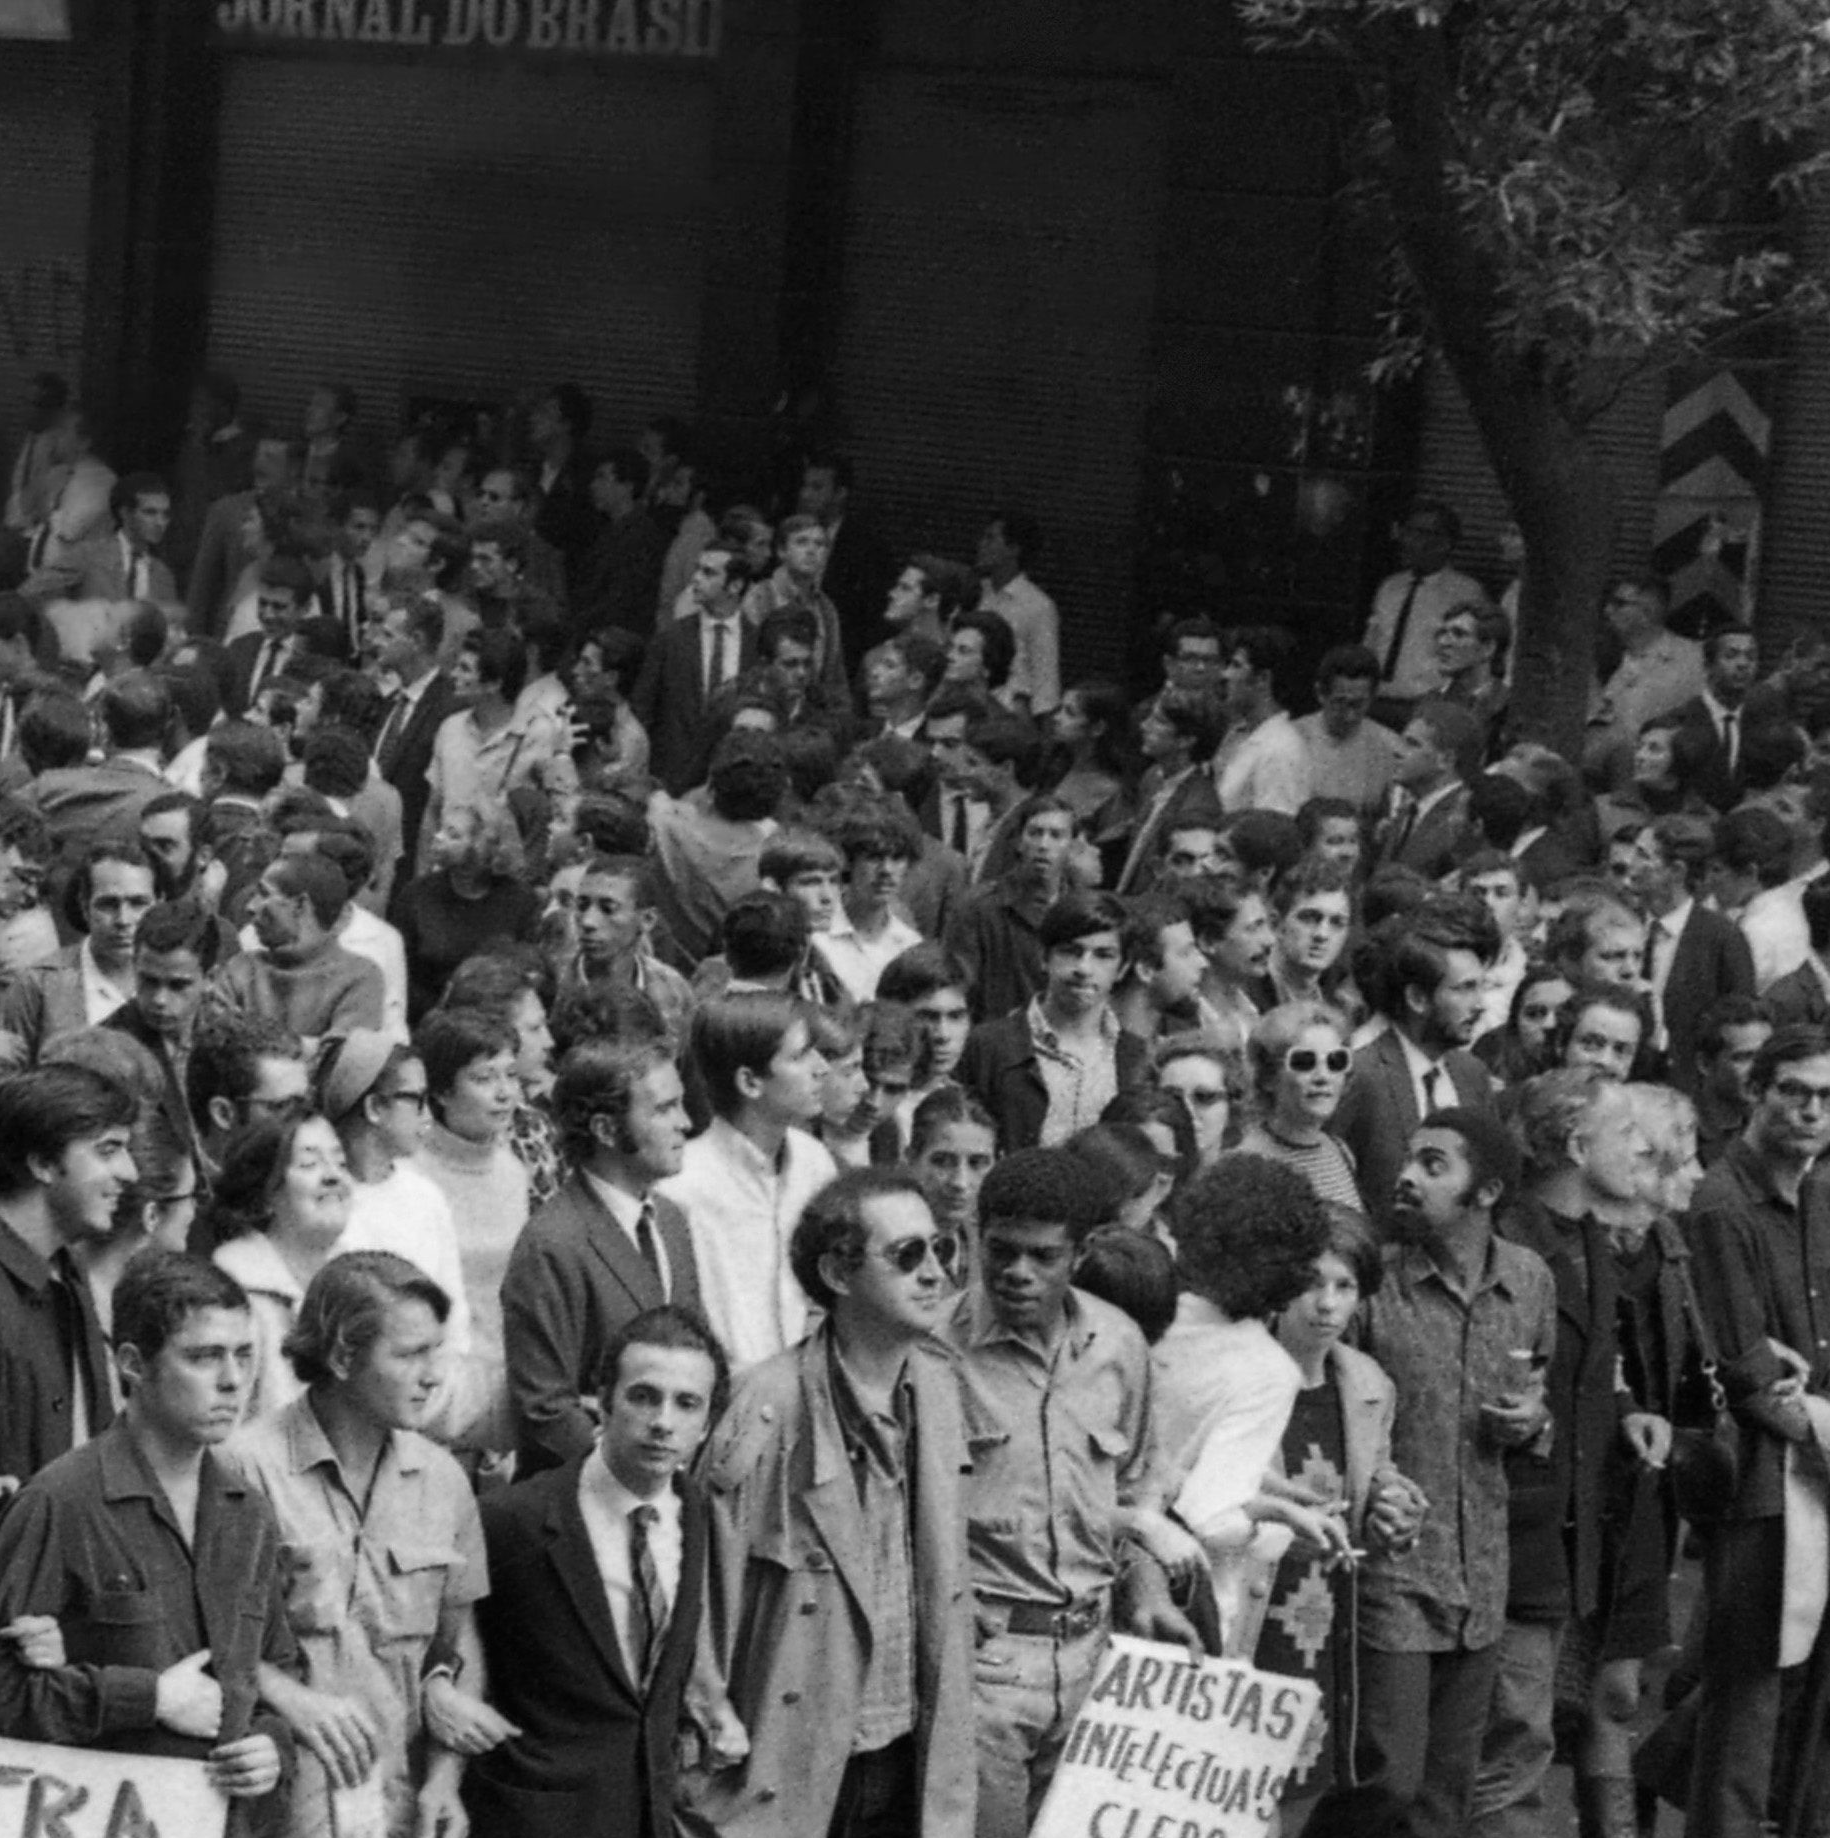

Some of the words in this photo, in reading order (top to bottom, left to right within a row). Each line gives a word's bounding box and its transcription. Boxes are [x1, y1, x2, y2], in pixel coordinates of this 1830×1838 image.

[217, 0, 431, 44] JORNAL
[441, 0, 519, 46] DO
[1091, 1651, 1303, 1742] ARTISTAS
